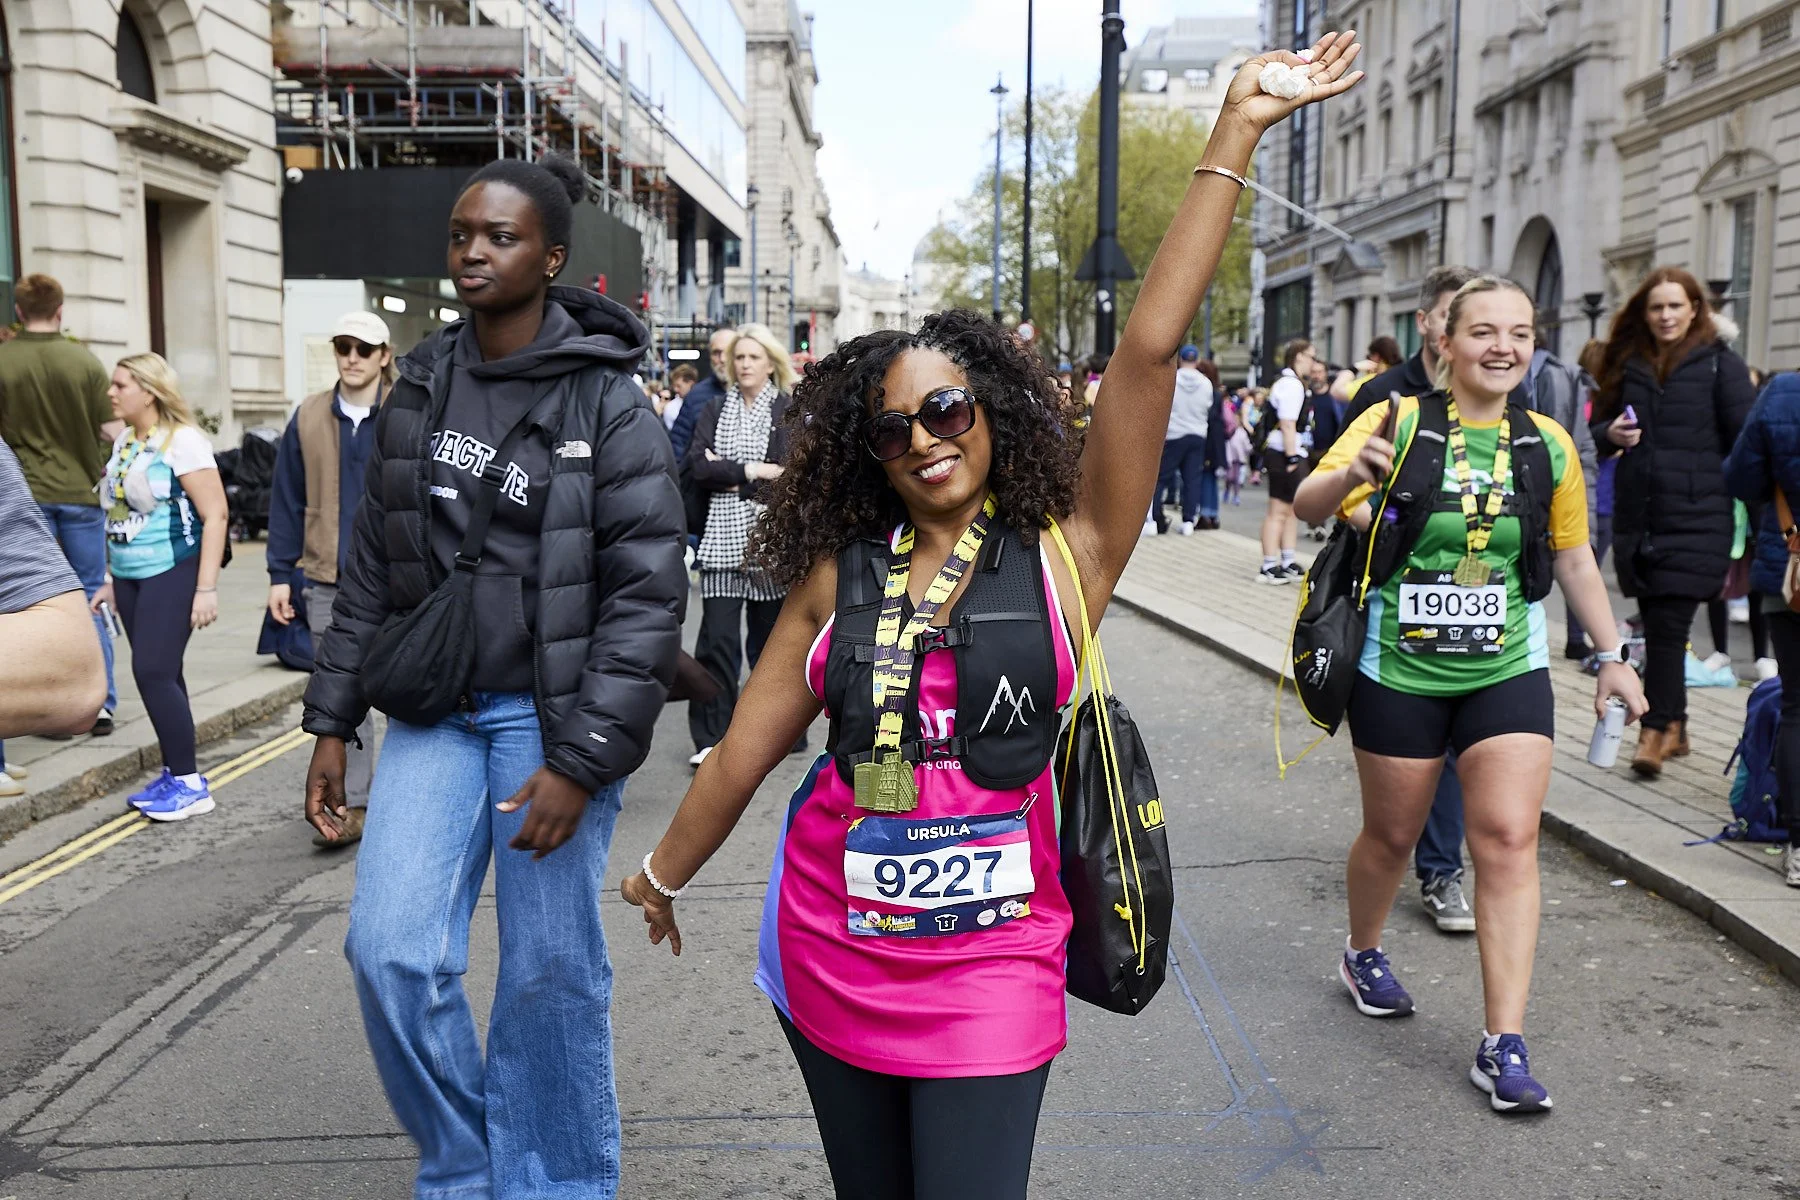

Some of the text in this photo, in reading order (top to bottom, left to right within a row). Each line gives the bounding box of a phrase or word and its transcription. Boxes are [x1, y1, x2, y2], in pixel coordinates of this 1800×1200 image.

[1408, 592, 1499, 617] 19038
[907, 823, 970, 840] URSULA
[874, 850, 1002, 898] 9227
